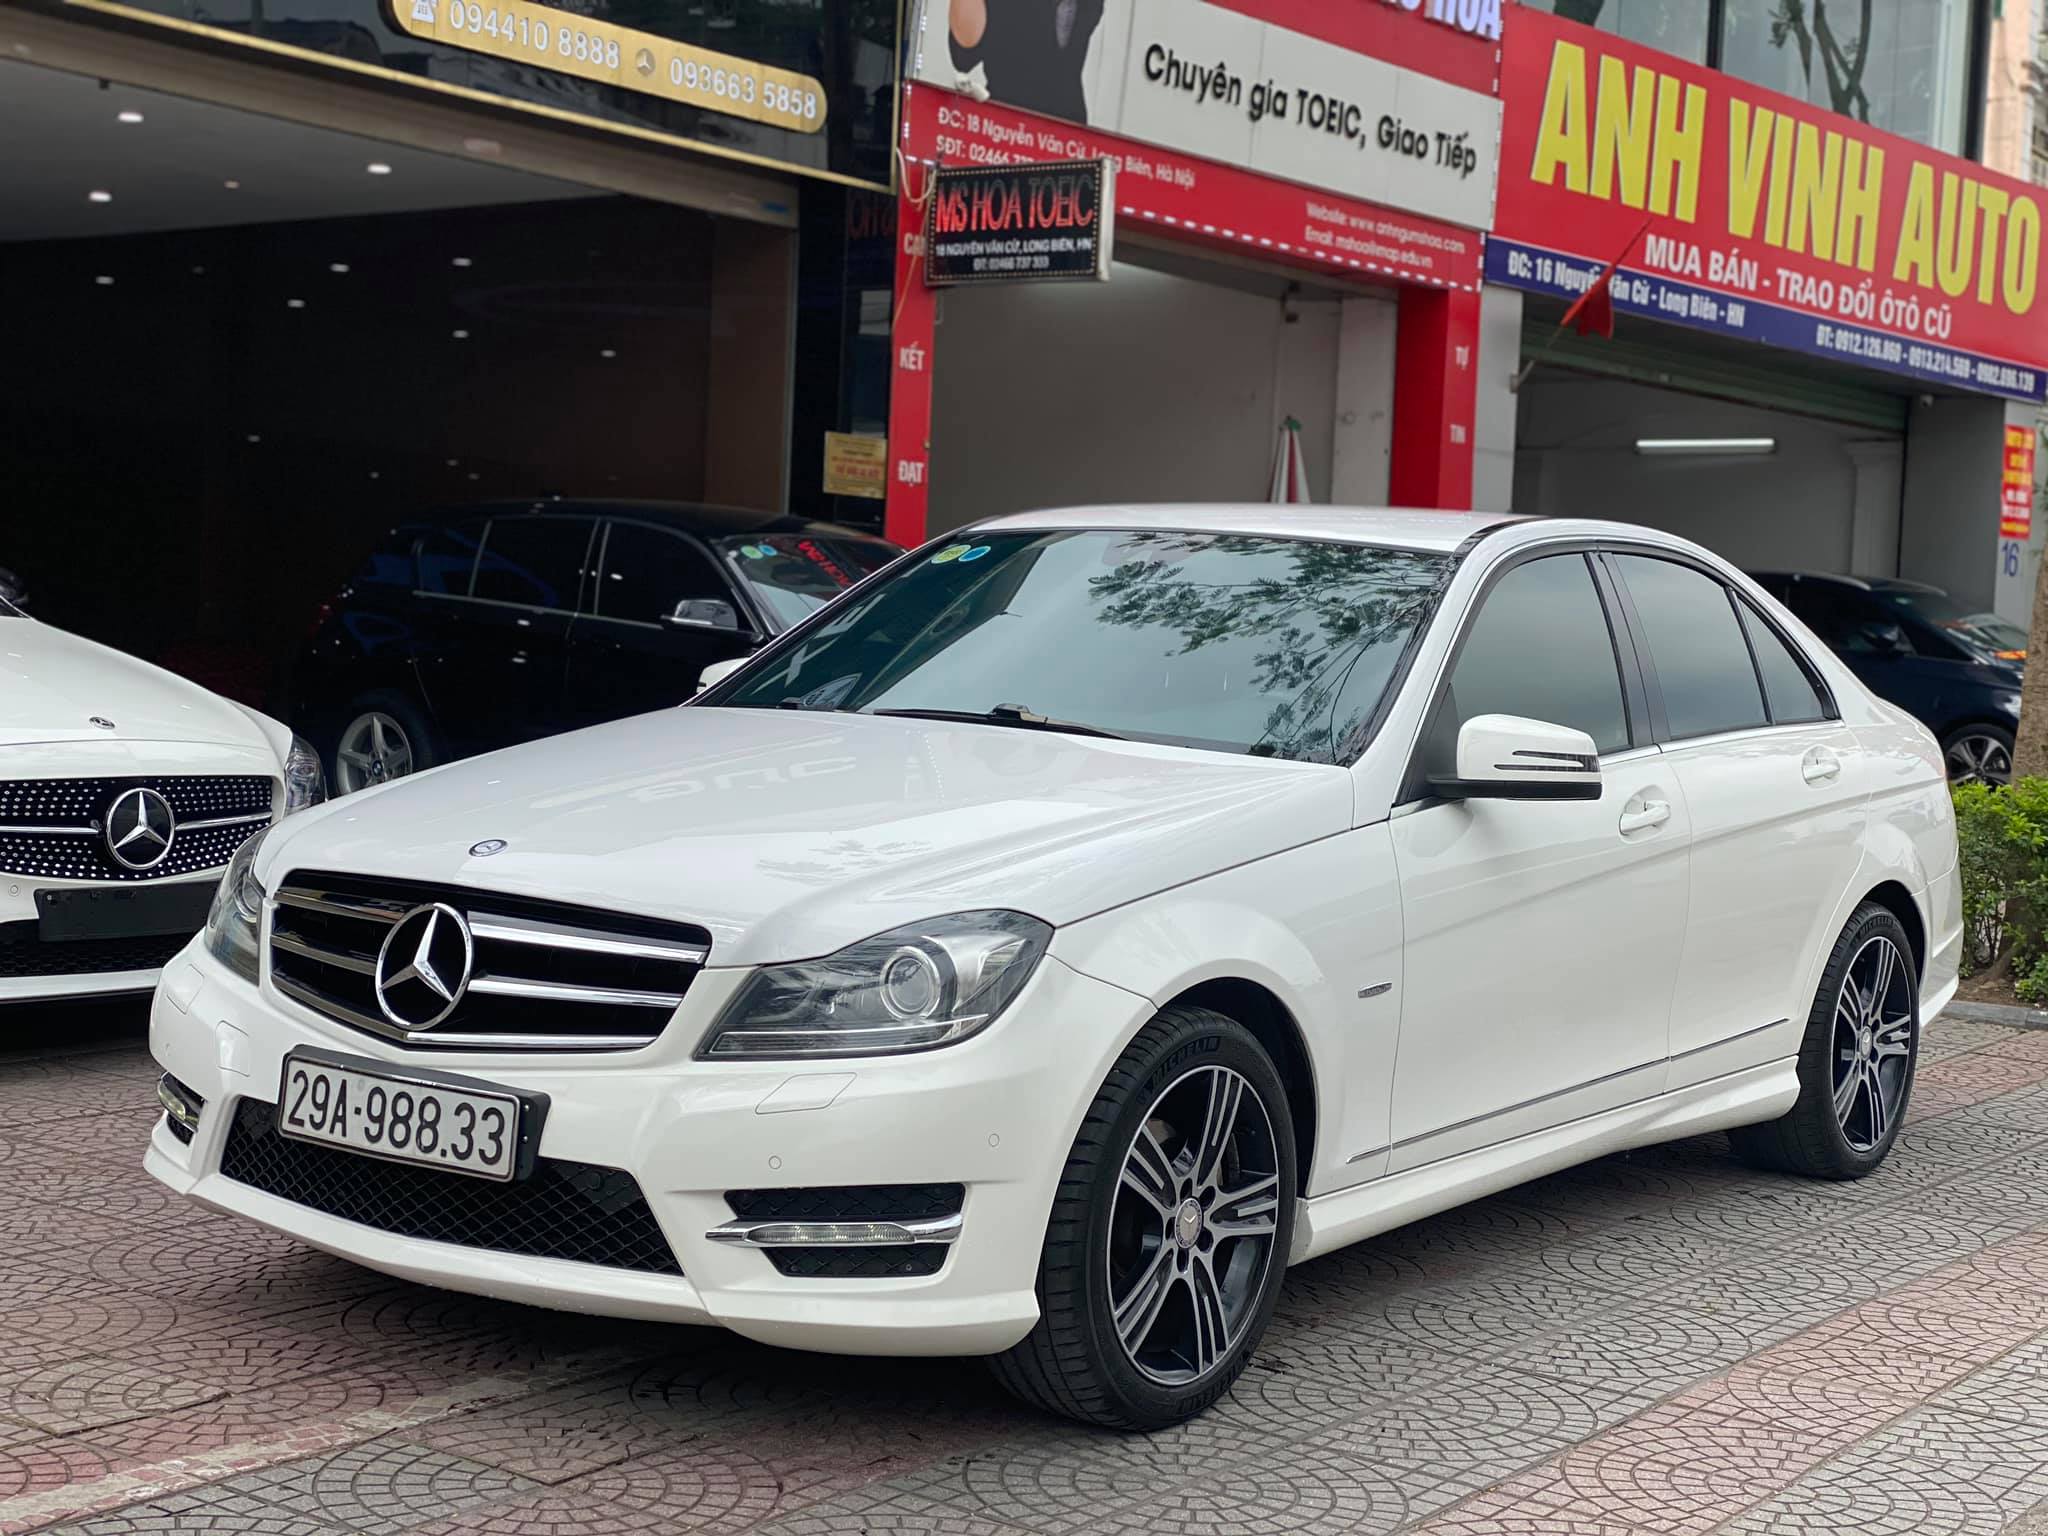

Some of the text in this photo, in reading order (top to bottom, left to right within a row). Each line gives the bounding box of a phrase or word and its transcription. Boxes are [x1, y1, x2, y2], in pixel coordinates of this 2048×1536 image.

[448, 0, 620, 69] 094410 8888
[670, 57, 817, 119] 093663 5858
[1144, 43, 1477, 179] Chuyên gia TOEIC, Giao Tiếp
[936, 135, 966, 158] SĐT:
[937, 107, 965, 129] ĐC:
[967, 113, 979, 130] 18
[982, 121, 1034, 147] Nguyễn
[1037, 132, 1064, 155] Văn
[1092, 145, 1122, 174] Lg
[1125, 156, 1153, 177] Biên,
[1155, 163, 1173, 181] Hà
[1174, 167, 1195, 191] Nội
[1530, 39, 2041, 315] ANH VINH AUTO
[936, 182, 967, 232] MS
[971, 179, 1023, 231] HOA
[1028, 174, 1094, 229] TOEIC
[1023, 238, 1050, 252] LONG
[1077, 237, 1091, 250] HN
[1508, 251, 1532, 279] ĐC:
[1536, 257, 1552, 277] 16
[1554, 262, 1601, 293] Nguyễ
[1632, 277, 1651, 305] Cừ
[1659, 286, 1688, 317] Long
[1690, 292, 1717, 321] Biên
[1727, 303, 1746, 327] HN
[1644, 234, 1702, 278] MUA
[1708, 248, 1758, 290] BÁN
[1777, 268, 1833, 309] TRAO
[1838, 277, 1875, 319] ĐỔI
[1879, 289, 1919, 335] ÔTÔ
[1924, 304, 1951, 339] CŨ
[899, 342, 925, 371] KẾT
[1816, 323, 1834, 349] ĐT:
[898, 459, 924, 487] ĐẠT
[2002, 541, 2019, 576] 16
[288, 1070, 505, 1165] 29A-988.33
